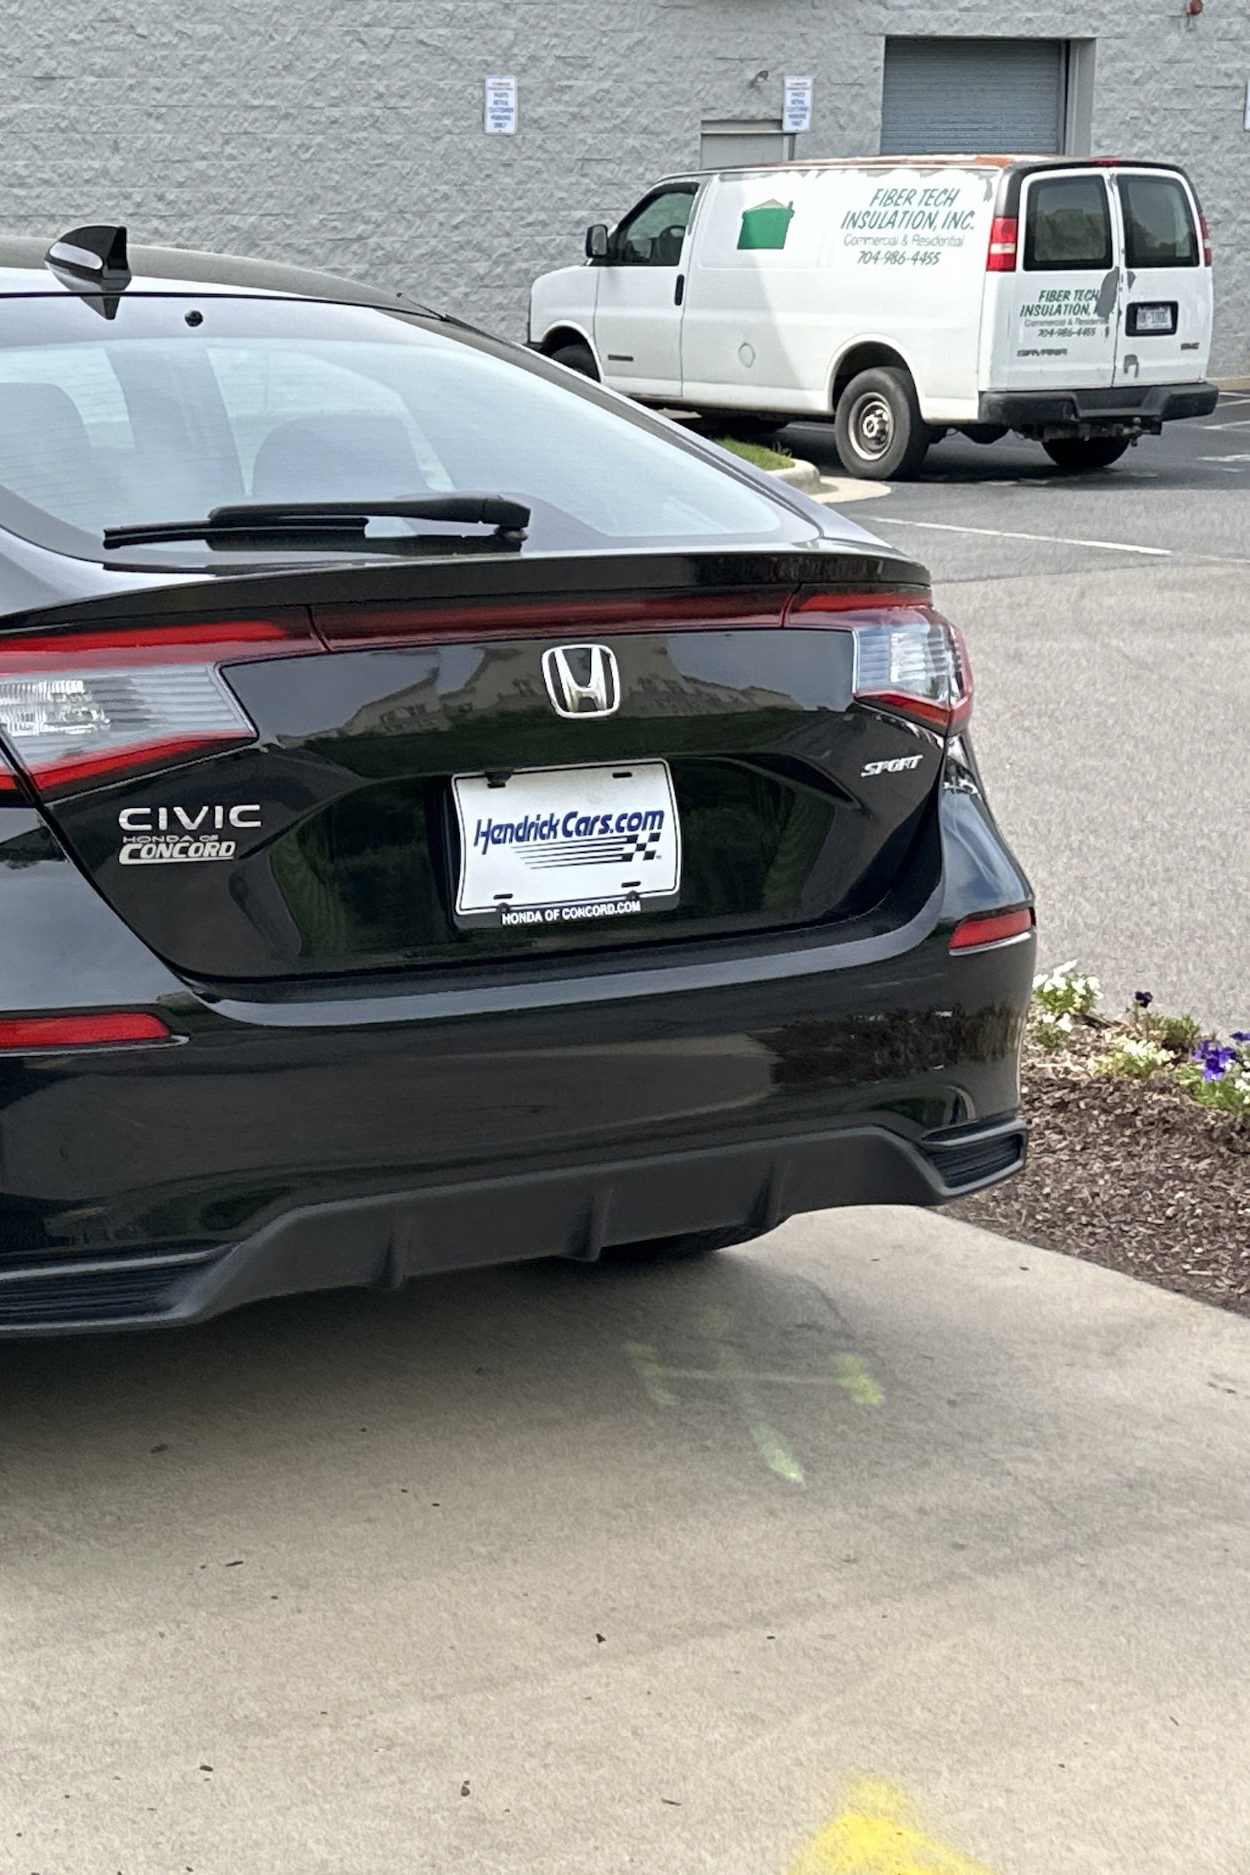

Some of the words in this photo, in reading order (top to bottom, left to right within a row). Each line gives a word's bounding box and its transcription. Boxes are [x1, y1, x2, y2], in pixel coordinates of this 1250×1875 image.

[869, 188, 916, 207] FIBER
[916, 187, 961, 207] TECH
[840, 211, 938, 231] INSULATION,
[941, 210, 975, 230] INC.
[857, 250, 941, 266] 704-986-4455
[1038, 290, 1071, 302] FIBER
[860, 754, 924, 777] SPORT
[118, 804, 262, 831] CIVIC
[122, 835, 195, 844] HONDA
[199, 834, 219, 842] OF
[118, 841, 236, 866] CONCORD
[502, 910, 543, 925] HONDA
[545, 909, 561, 921] OF
[562, 900, 641, 918] CONCORD.COM
